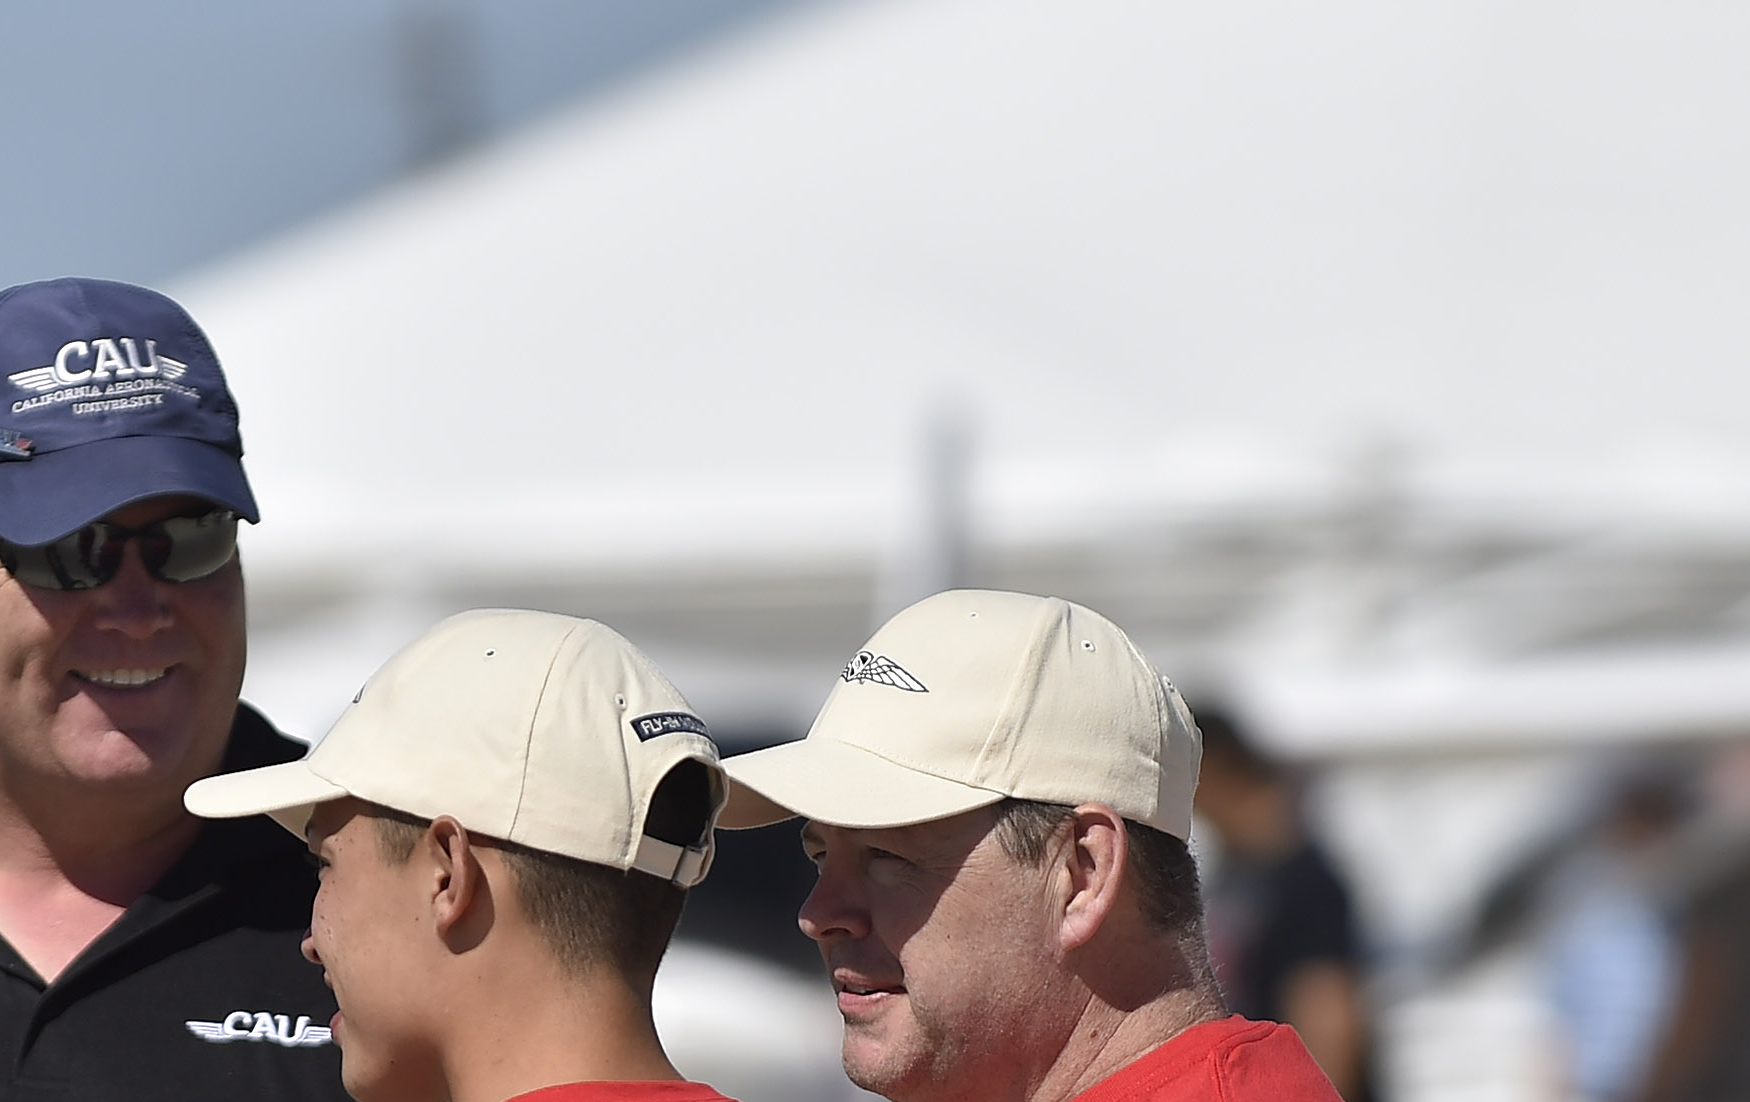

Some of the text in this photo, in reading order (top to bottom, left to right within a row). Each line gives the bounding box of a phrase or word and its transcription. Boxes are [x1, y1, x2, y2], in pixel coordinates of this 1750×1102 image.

[54, 337, 158, 385] CAU
[11, 385, 102, 414] CALIFORNIA
[72, 393, 164, 416] UNIVERSITY
[223, 1010, 311, 1045] CAU
